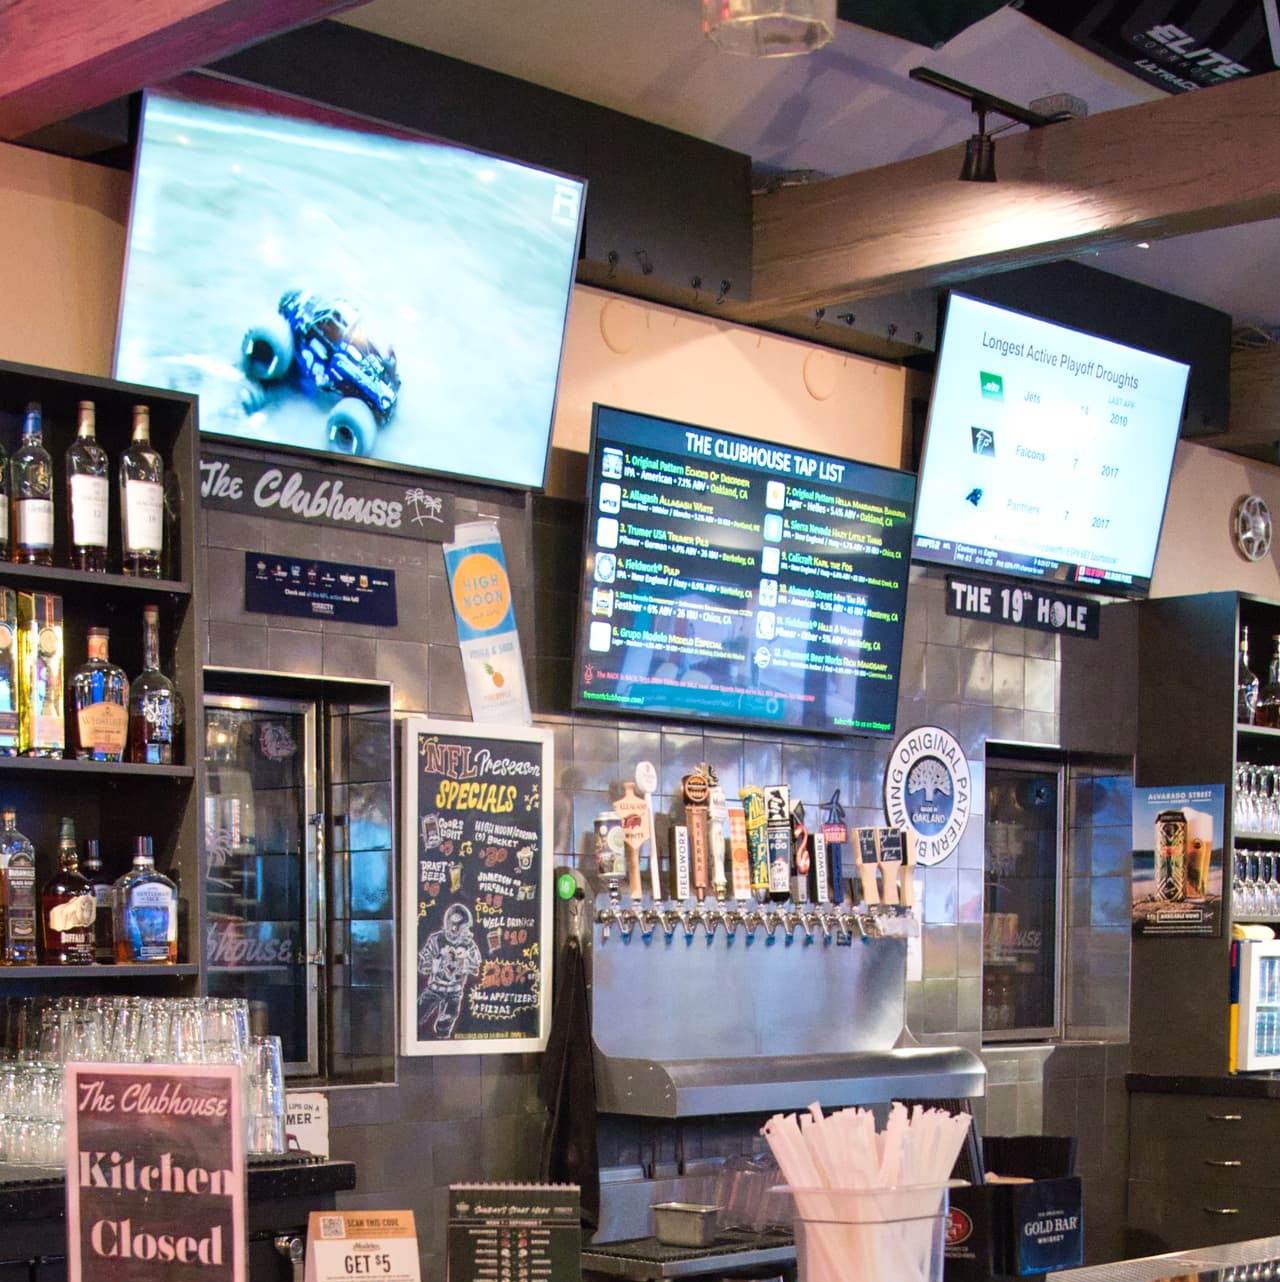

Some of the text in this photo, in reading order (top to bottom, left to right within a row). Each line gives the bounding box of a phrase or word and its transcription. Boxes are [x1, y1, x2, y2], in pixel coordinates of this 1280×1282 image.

[1145, 23, 1251, 80] ELITE
[982, 331, 1139, 389] Longest Active Playoff Droughts
[1024, 391, 1041, 405] Jets
[1110, 413, 1128, 427] 2010
[686, 432, 844, 483] THE CLUBHOUSE TAP LIST
[1015, 445, 1046, 462] Falcons
[631, 455, 659, 470] Original
[660, 460, 685, 475] Pattern
[1101, 465, 1119, 478] 2017
[640, 470, 673, 485] American
[199, 459, 404, 529] The Clubhouse
[627, 524, 667, 541] Trumer USA
[1091, 517, 1110, 529] 2017
[463, 573, 500, 591] HIGH
[464, 590, 504, 609] NOON
[951, 581, 1088, 631] THE 19th HOLE
[620, 628, 641, 640] Grupo
[424, 742, 541, 780] NFL Preseason
[900, 732, 961, 773] ORIGINAL
[435, 779, 517, 814] SPECIALS
[1147, 791, 1212, 801] ALVARADO STREET
[912, 813, 946, 824] OAKLAND
[930, 776, 968, 858] PATTERN
[770, 842, 788, 850] FOG
[419, 860, 448, 872] DRAFT
[679, 829, 688, 897] FIELDWORK
[815, 836, 826, 900] FIELDWORK
[420, 871, 447, 883] BEER
[482, 916, 535, 929] WELL DRINKS
[489, 992, 538, 1003] APPETIZERS
[78, 1080, 229, 1119] The Clubhouse
[79, 1150, 234, 1197] Kitchen
[1024, 1217, 1077, 1237] GOLD BAR
[90, 1218, 224, 1267] Closed
[344, 1253, 391, 1274] GET $5
